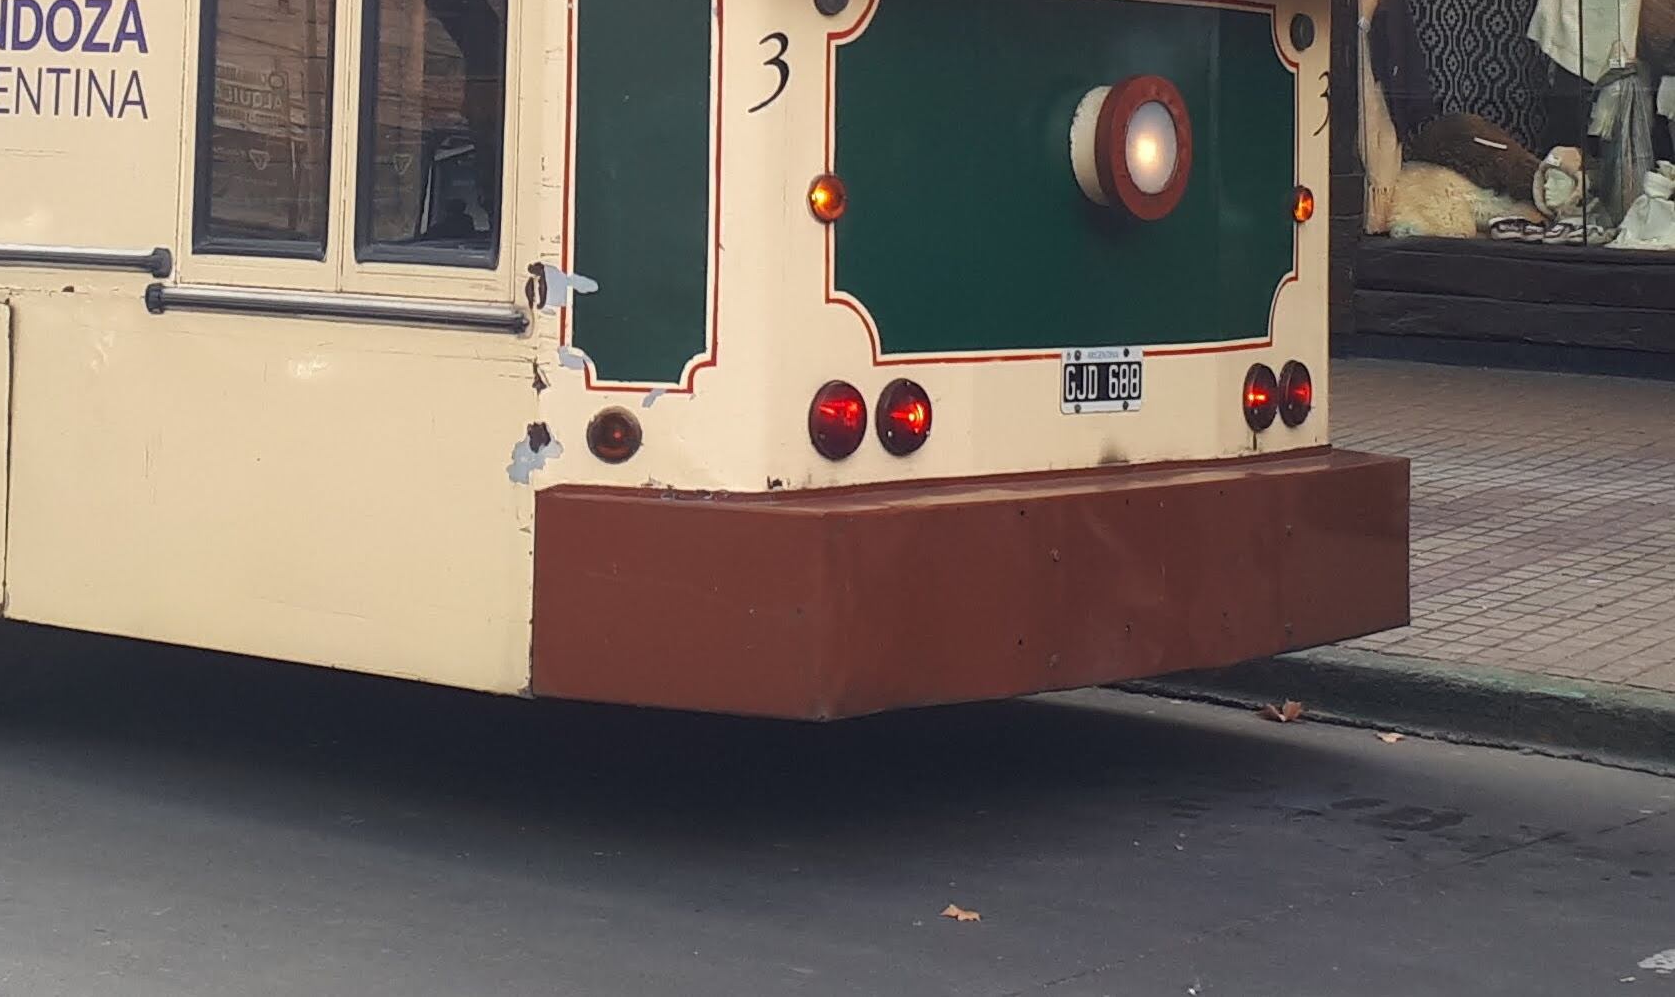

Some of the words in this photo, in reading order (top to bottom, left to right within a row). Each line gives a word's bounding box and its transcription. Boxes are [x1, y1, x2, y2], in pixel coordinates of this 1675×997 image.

[748, 31, 790, 113] 3
[1065, 364, 1099, 401] GJD
[1108, 363, 1141, 399] 688
